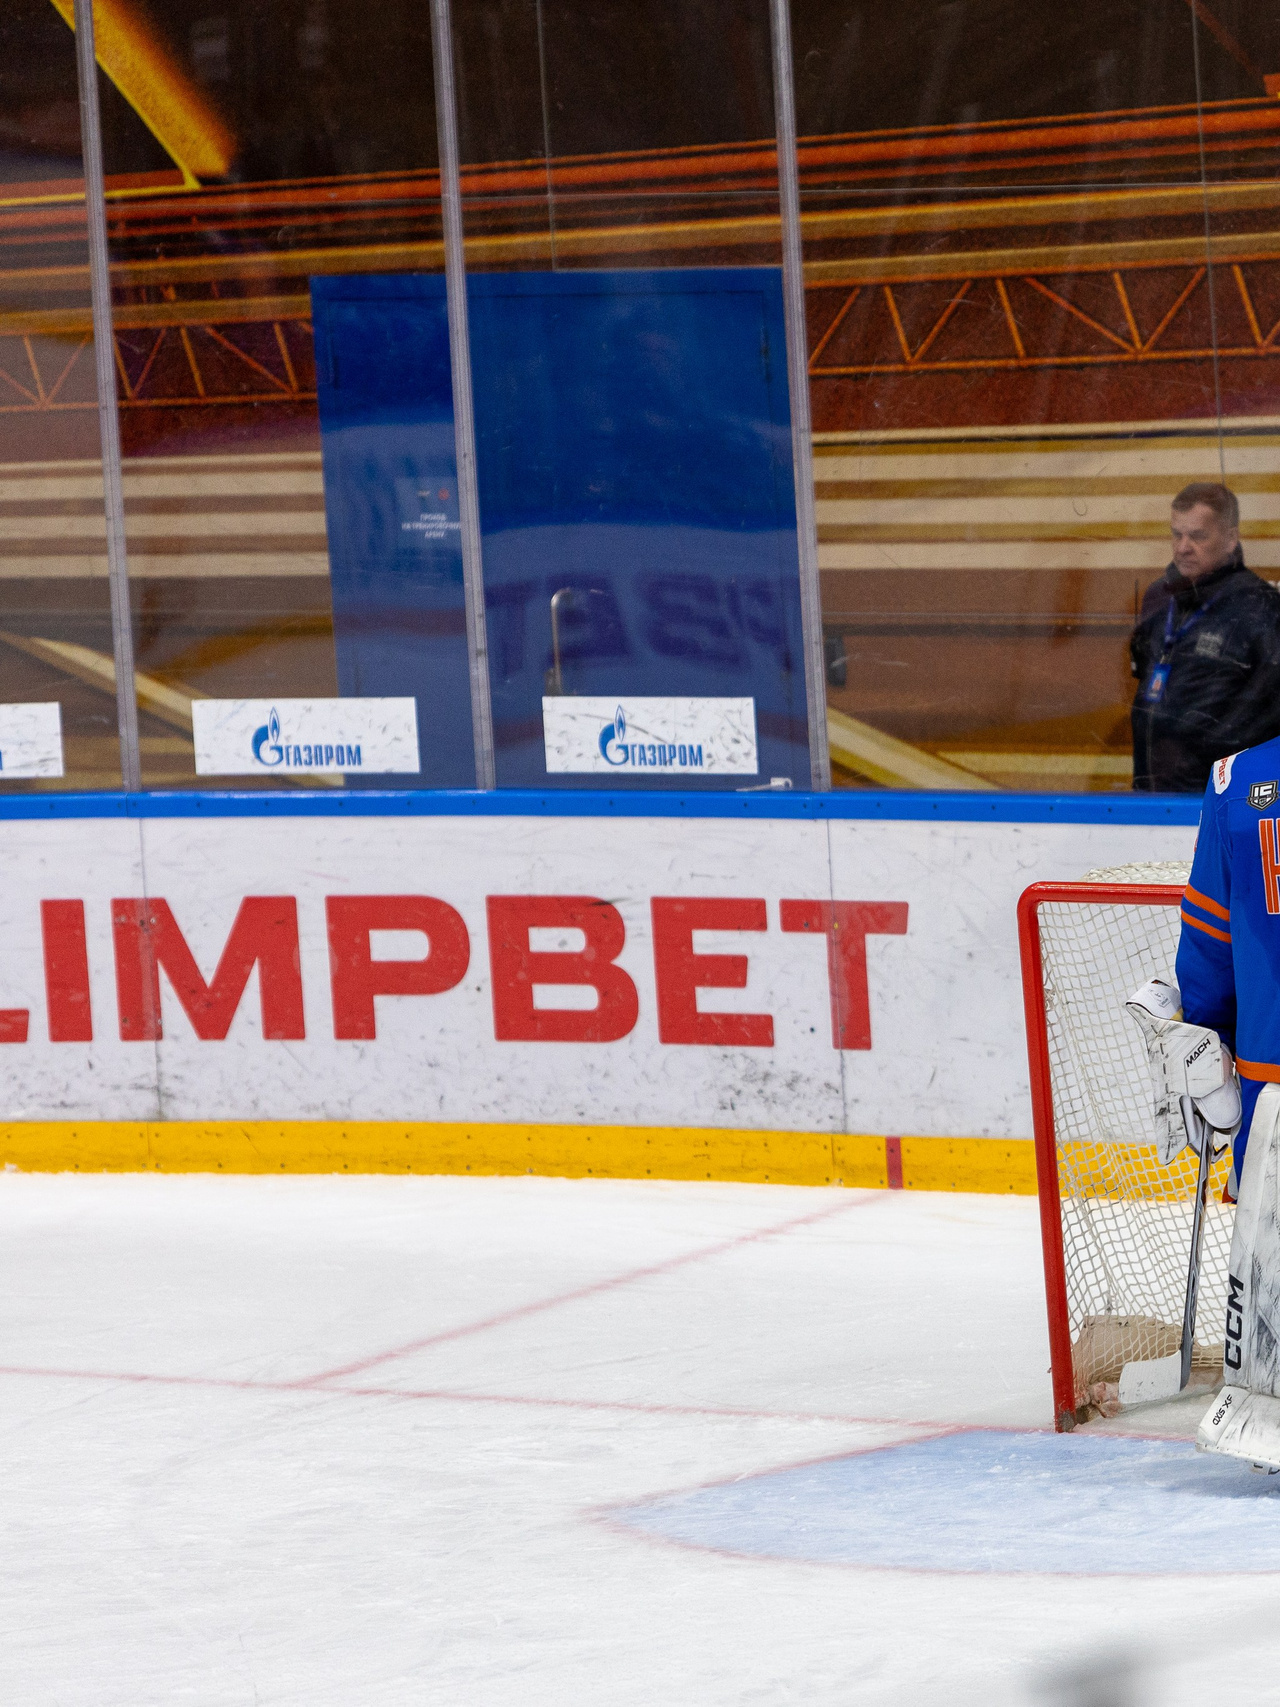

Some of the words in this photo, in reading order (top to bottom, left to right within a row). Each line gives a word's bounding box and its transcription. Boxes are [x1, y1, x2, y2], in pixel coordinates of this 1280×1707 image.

[284, 743, 362, 766] ГАЗПРОМ
[630, 743, 703, 767] ГАЗПРОМ
[0, 894, 909, 1051] IMPBET
[1186, 1038, 1211, 1067] MACH
[1224, 1273, 1244, 1371] CCM
